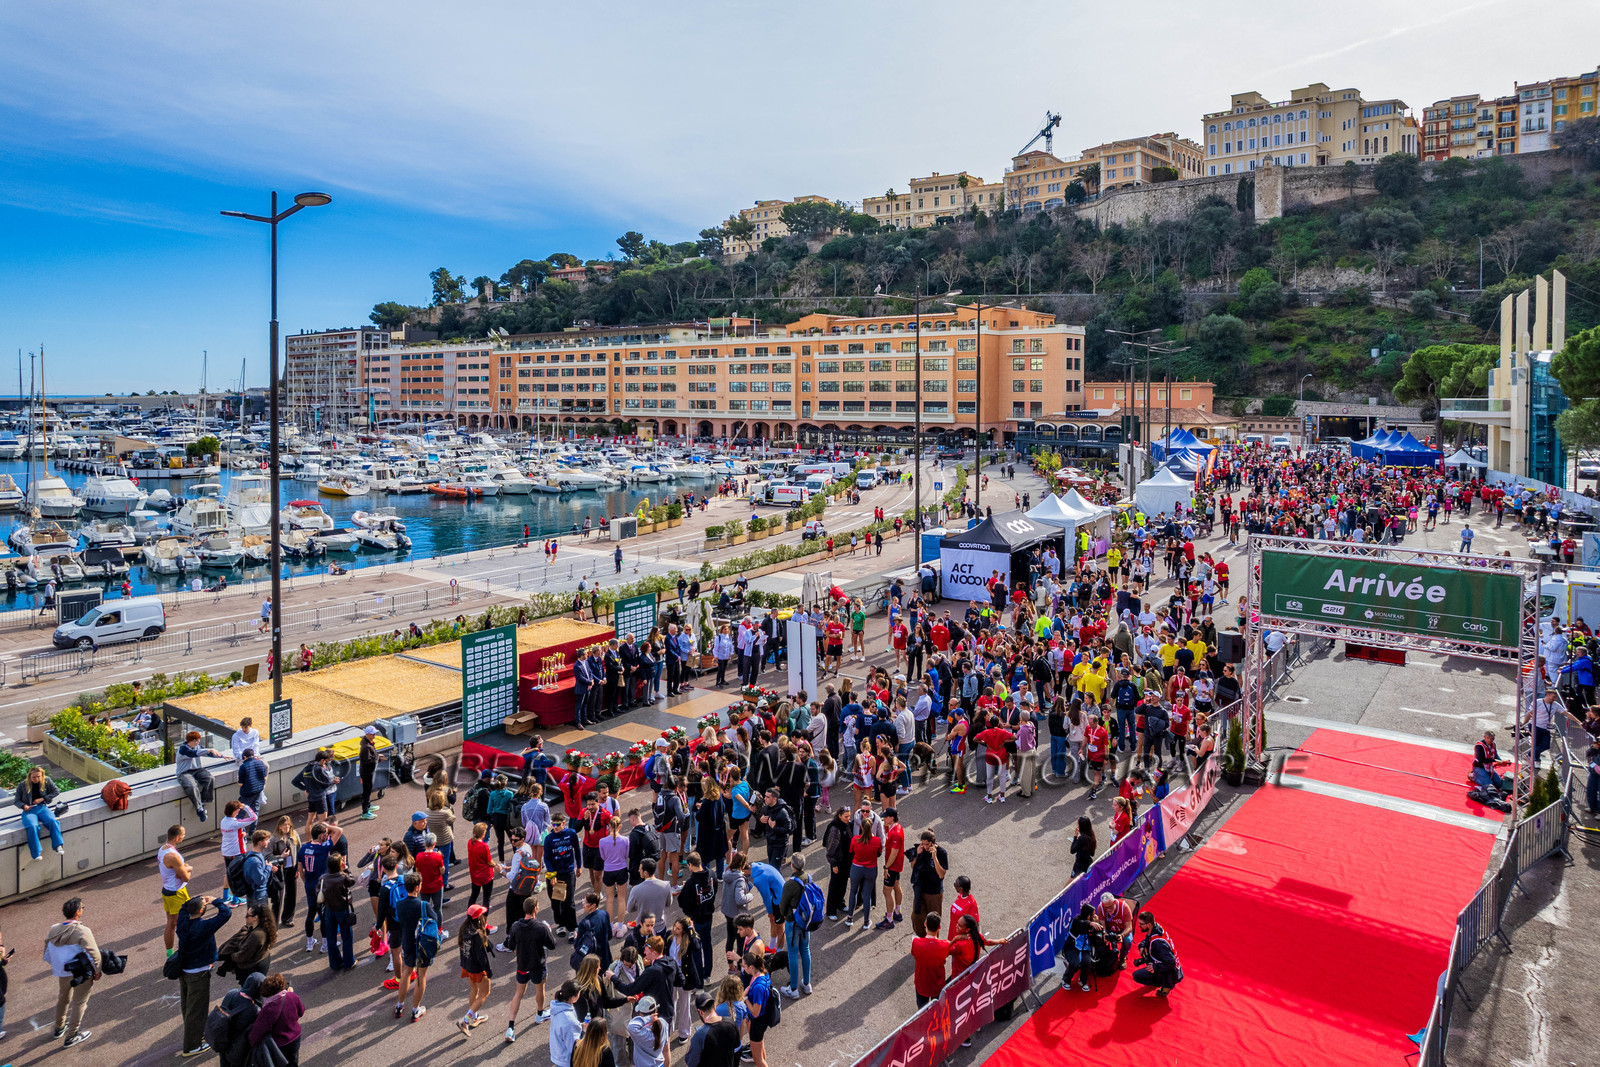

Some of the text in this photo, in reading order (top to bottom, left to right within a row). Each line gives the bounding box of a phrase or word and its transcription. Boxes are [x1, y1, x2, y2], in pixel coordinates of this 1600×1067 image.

[951, 563, 974, 574] ACT
[1322, 568, 1447, 604] Arrivée
[1461, 621, 1489, 632] Carlo
[304, 855, 315, 872] 17
[1121, 855, 1138, 872] LOCAL
[955, 942, 1028, 1011] CYCLE
[954, 963, 1026, 1035] PASSION
